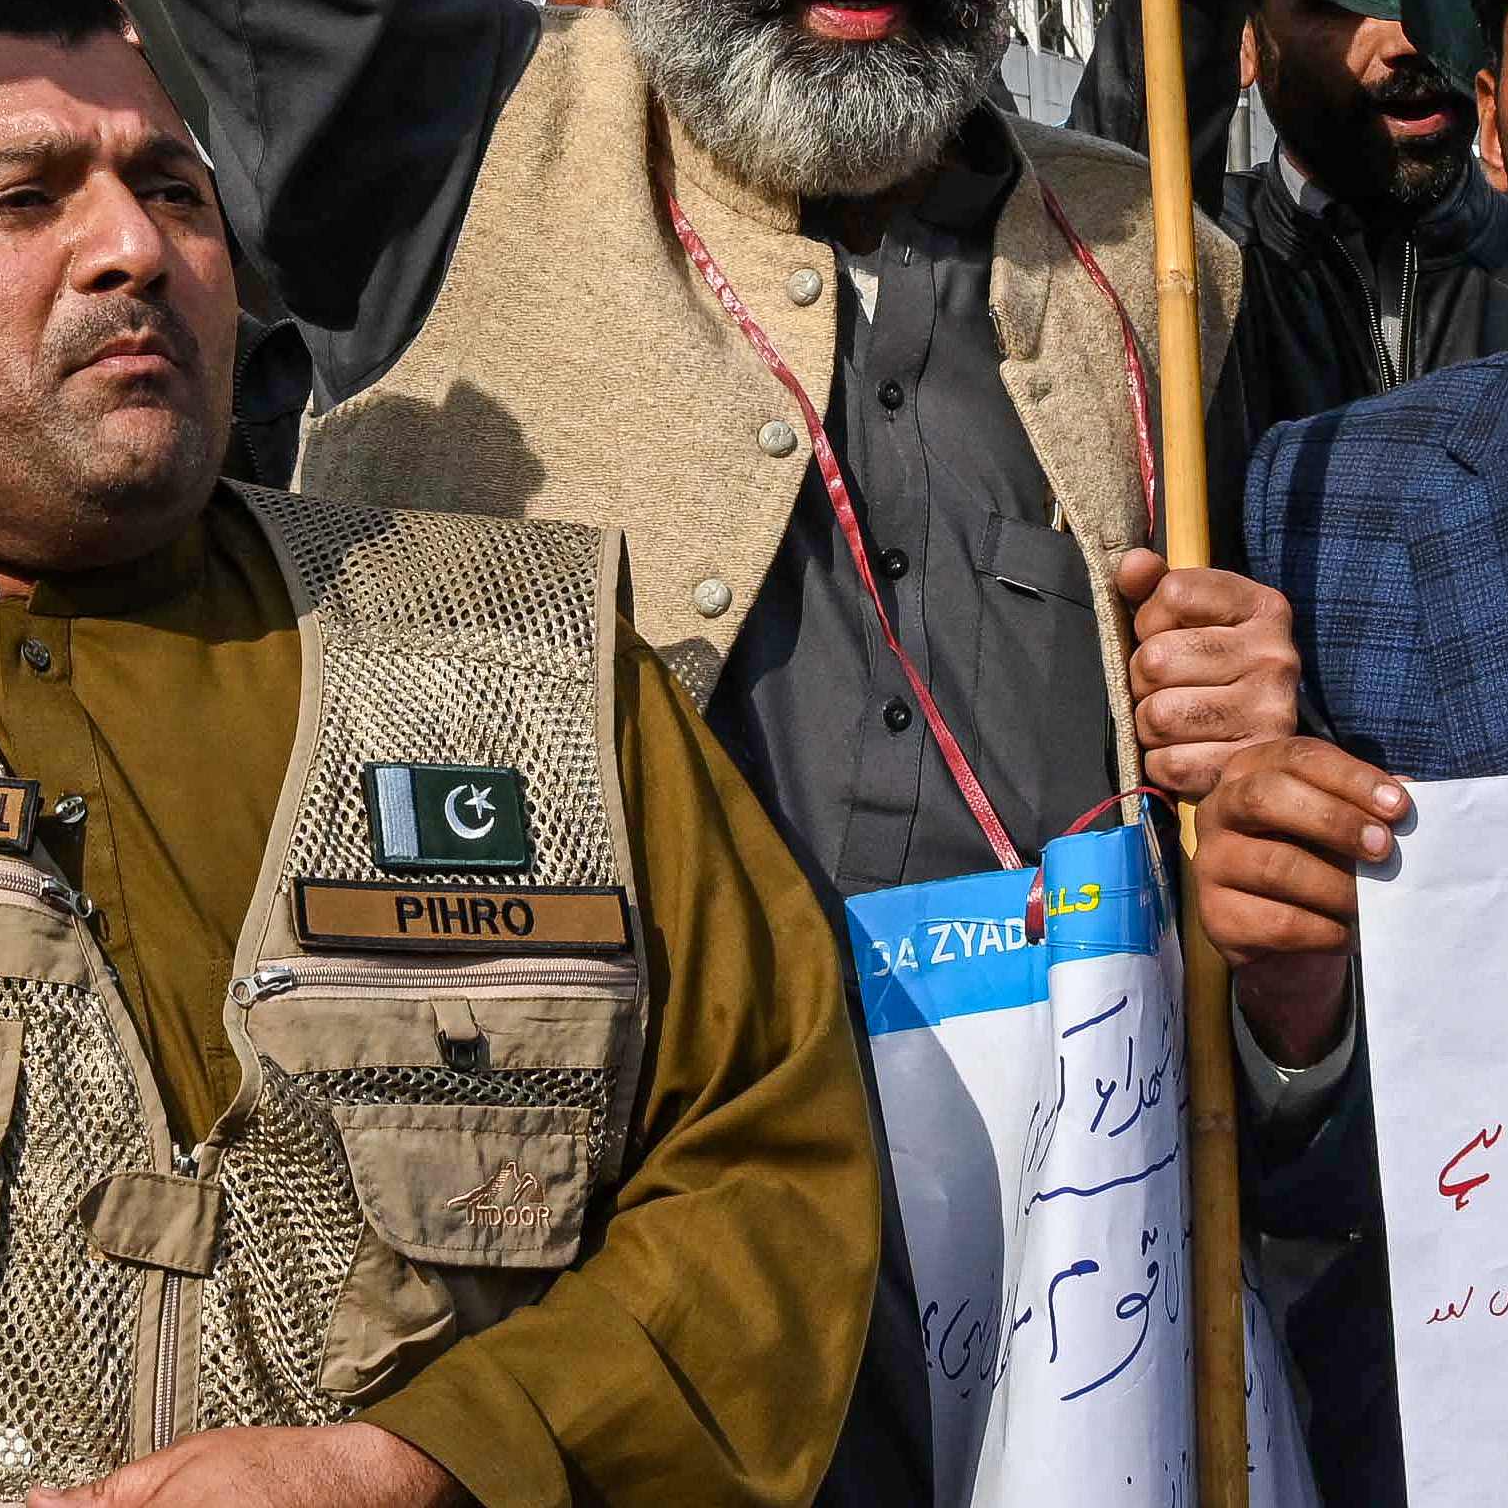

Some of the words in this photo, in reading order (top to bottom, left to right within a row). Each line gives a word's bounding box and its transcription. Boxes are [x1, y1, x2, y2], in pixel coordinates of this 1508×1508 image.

[394, 895, 536, 937] PIHRO
[927, 917, 1045, 965] ZYAD
[1438, 1123, 1503, 1211] ہے
